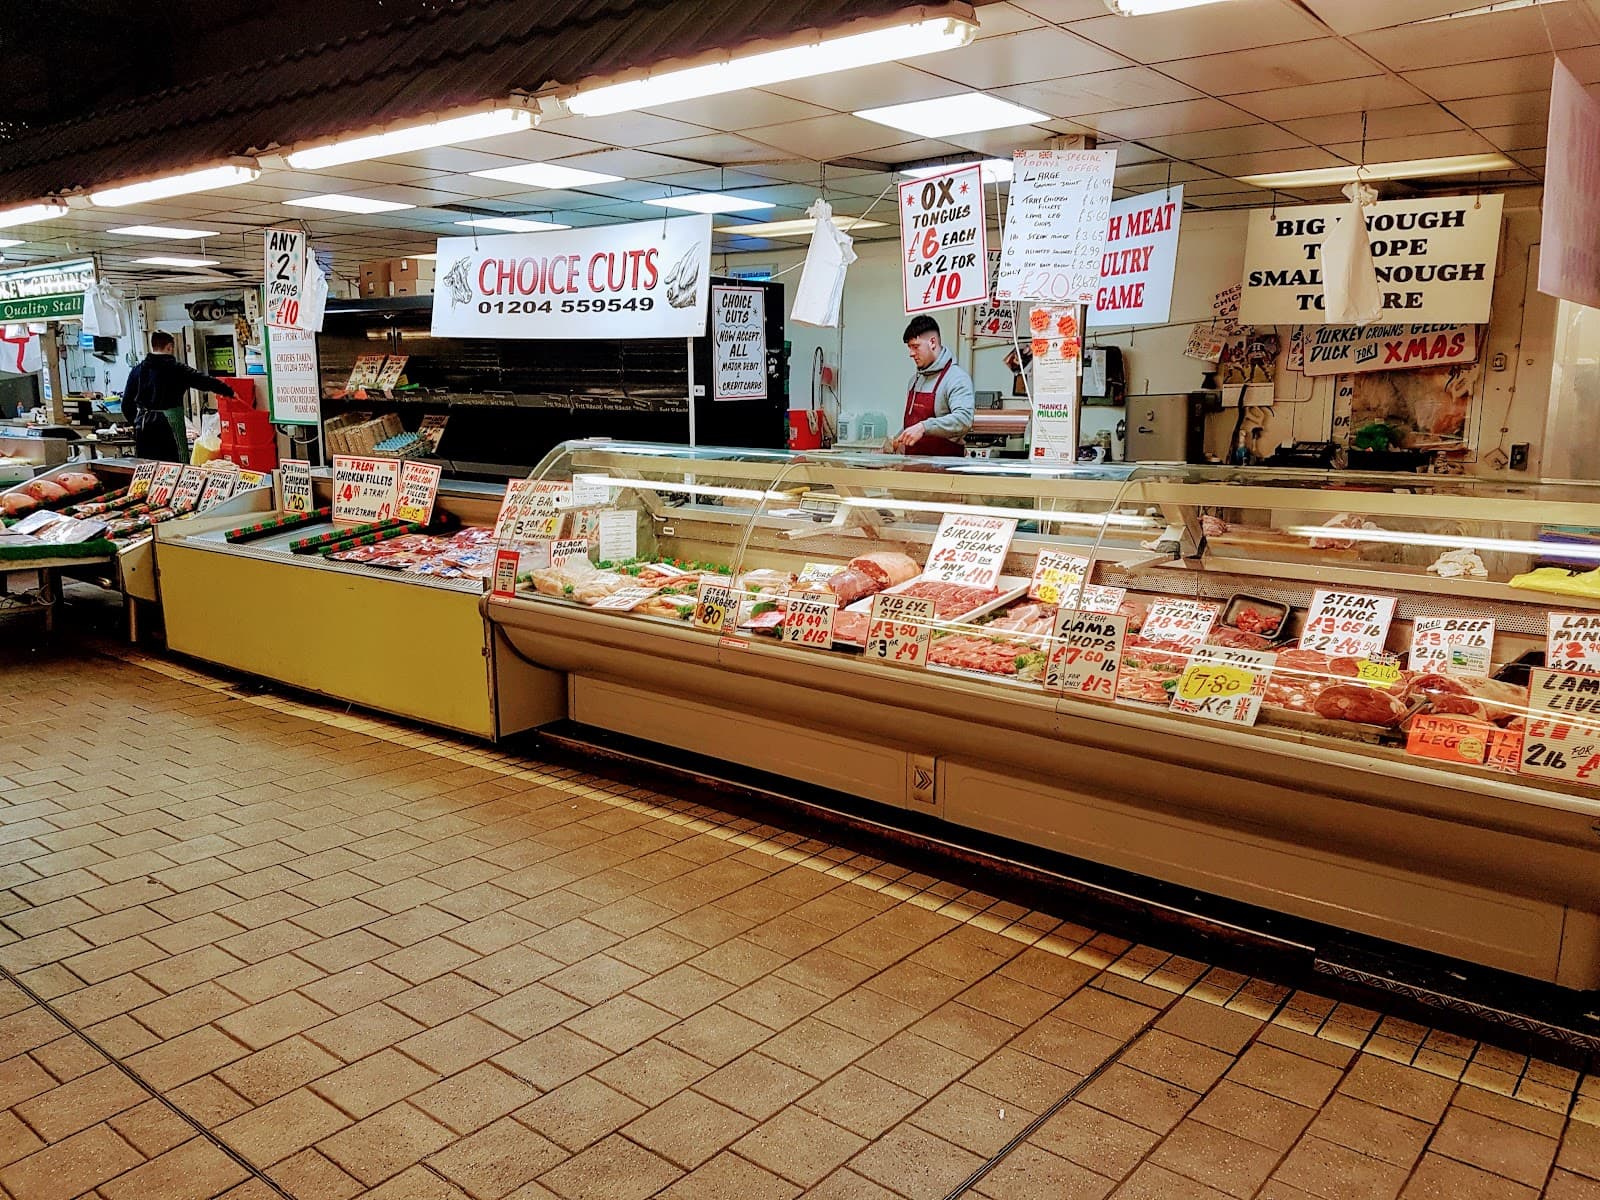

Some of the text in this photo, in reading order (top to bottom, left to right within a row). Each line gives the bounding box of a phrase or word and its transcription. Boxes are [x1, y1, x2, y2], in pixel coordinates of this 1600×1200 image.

[921, 177, 955, 210] OX
[912, 204, 971, 229] TONGUES
[1125, 203, 1176, 239] MEAT
[1275, 218, 1325, 237] BIG
[269, 232, 297, 252] ANY
[908, 227, 977, 262] £6 EACH
[276, 254, 290, 280] 2
[478, 247, 659, 296] CHOICE CUTS
[914, 253, 976, 277] OR 2 FOR
[270, 281, 298, 297] TRAYS
[923, 272, 962, 304] £10
[722, 293, 752, 309] CHOICE
[1096, 282, 1145, 311] GAME
[4, 298, 80, 318] Quality Stall
[276, 298, 298, 324] £10
[478, 297, 654, 314] 01204 559549
[725, 311, 749, 323] CUTS
[719, 330, 759, 342] NOW ACCEPT
[1315, 324, 1404, 345] TURKEY CROWNS
[729, 343, 748, 358] ALL
[1310, 344, 1351, 362] DUCK
[1355, 344, 1373, 359] FOR
[1384, 332, 1466, 364] XMAS
[722, 361, 759, 371] MAJOR DEBIT
[351, 461, 374, 472] FRESH
[285, 475, 308, 485] CHICKEN
[336, 470, 393, 487] CHICKEN FILLETS
[284, 485, 308, 496] FILLETS
[516, 521, 524, 535] 3
[942, 526, 996, 540] SIRLOIN
[552, 547, 587, 557] PUDDING
[556, 540, 583, 549] BLACK
[955, 540, 1003, 554] STEAKS
[940, 563, 964, 571] ANY
[1040, 557, 1087, 575] STEAKS
[703, 595, 737, 609] BURGERS
[790, 601, 829, 616] STEAK
[880, 597, 928, 612] RIB EYE
[1323, 593, 1379, 610] STEAK
[1077, 612, 1107, 622] FRESH
[1155, 606, 1212, 621] STEAKS
[1320, 606, 1378, 622] MINCE
[1061, 619, 1116, 637] LAMB
[1307, 617, 1364, 635] £3.65
[1417, 620, 1490, 632] DICED BEEF
[792, 629, 799, 641] 2
[1058, 633, 1116, 651] CHOPS
[1315, 636, 1330, 650] 2
[878, 639, 887, 657] 3
[896, 642, 919, 660] £9
[1194, 649, 1216, 663] OX
[1047, 673, 1058, 686] 2
[1081, 675, 1112, 694] £13
[1183, 667, 1240, 695] £7.80
[1415, 718, 1470, 735] LAMB
[1418, 733, 1459, 748] LEG
[1571, 744, 1595, 756] FOR
